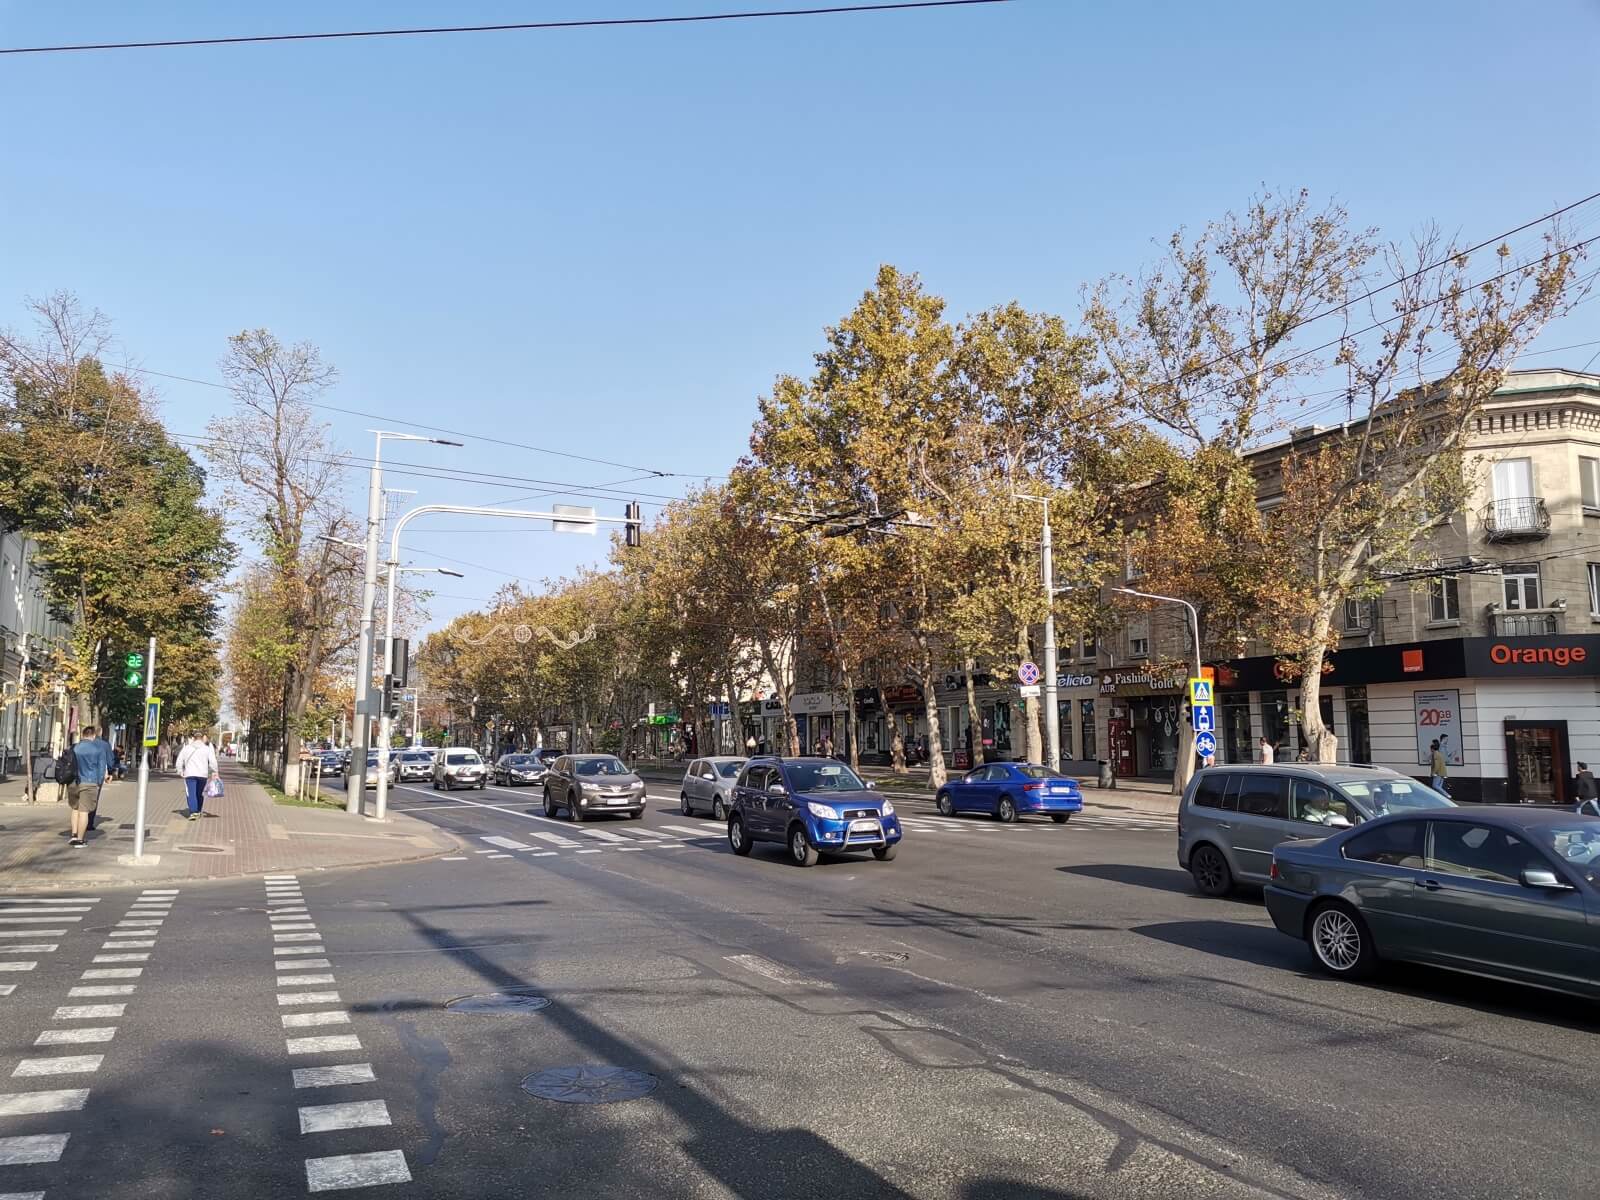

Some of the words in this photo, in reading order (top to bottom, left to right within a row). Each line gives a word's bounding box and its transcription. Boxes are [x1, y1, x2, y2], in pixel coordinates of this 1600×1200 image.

[1490, 644, 1586, 666] Orange
[1100, 684, 1116, 693] AUR
[1115, 672, 1153, 684] Fashion
[1150, 677, 1174, 689] Gold
[1419, 708, 1440, 726] 20
[1440, 710, 1452, 719] GB
